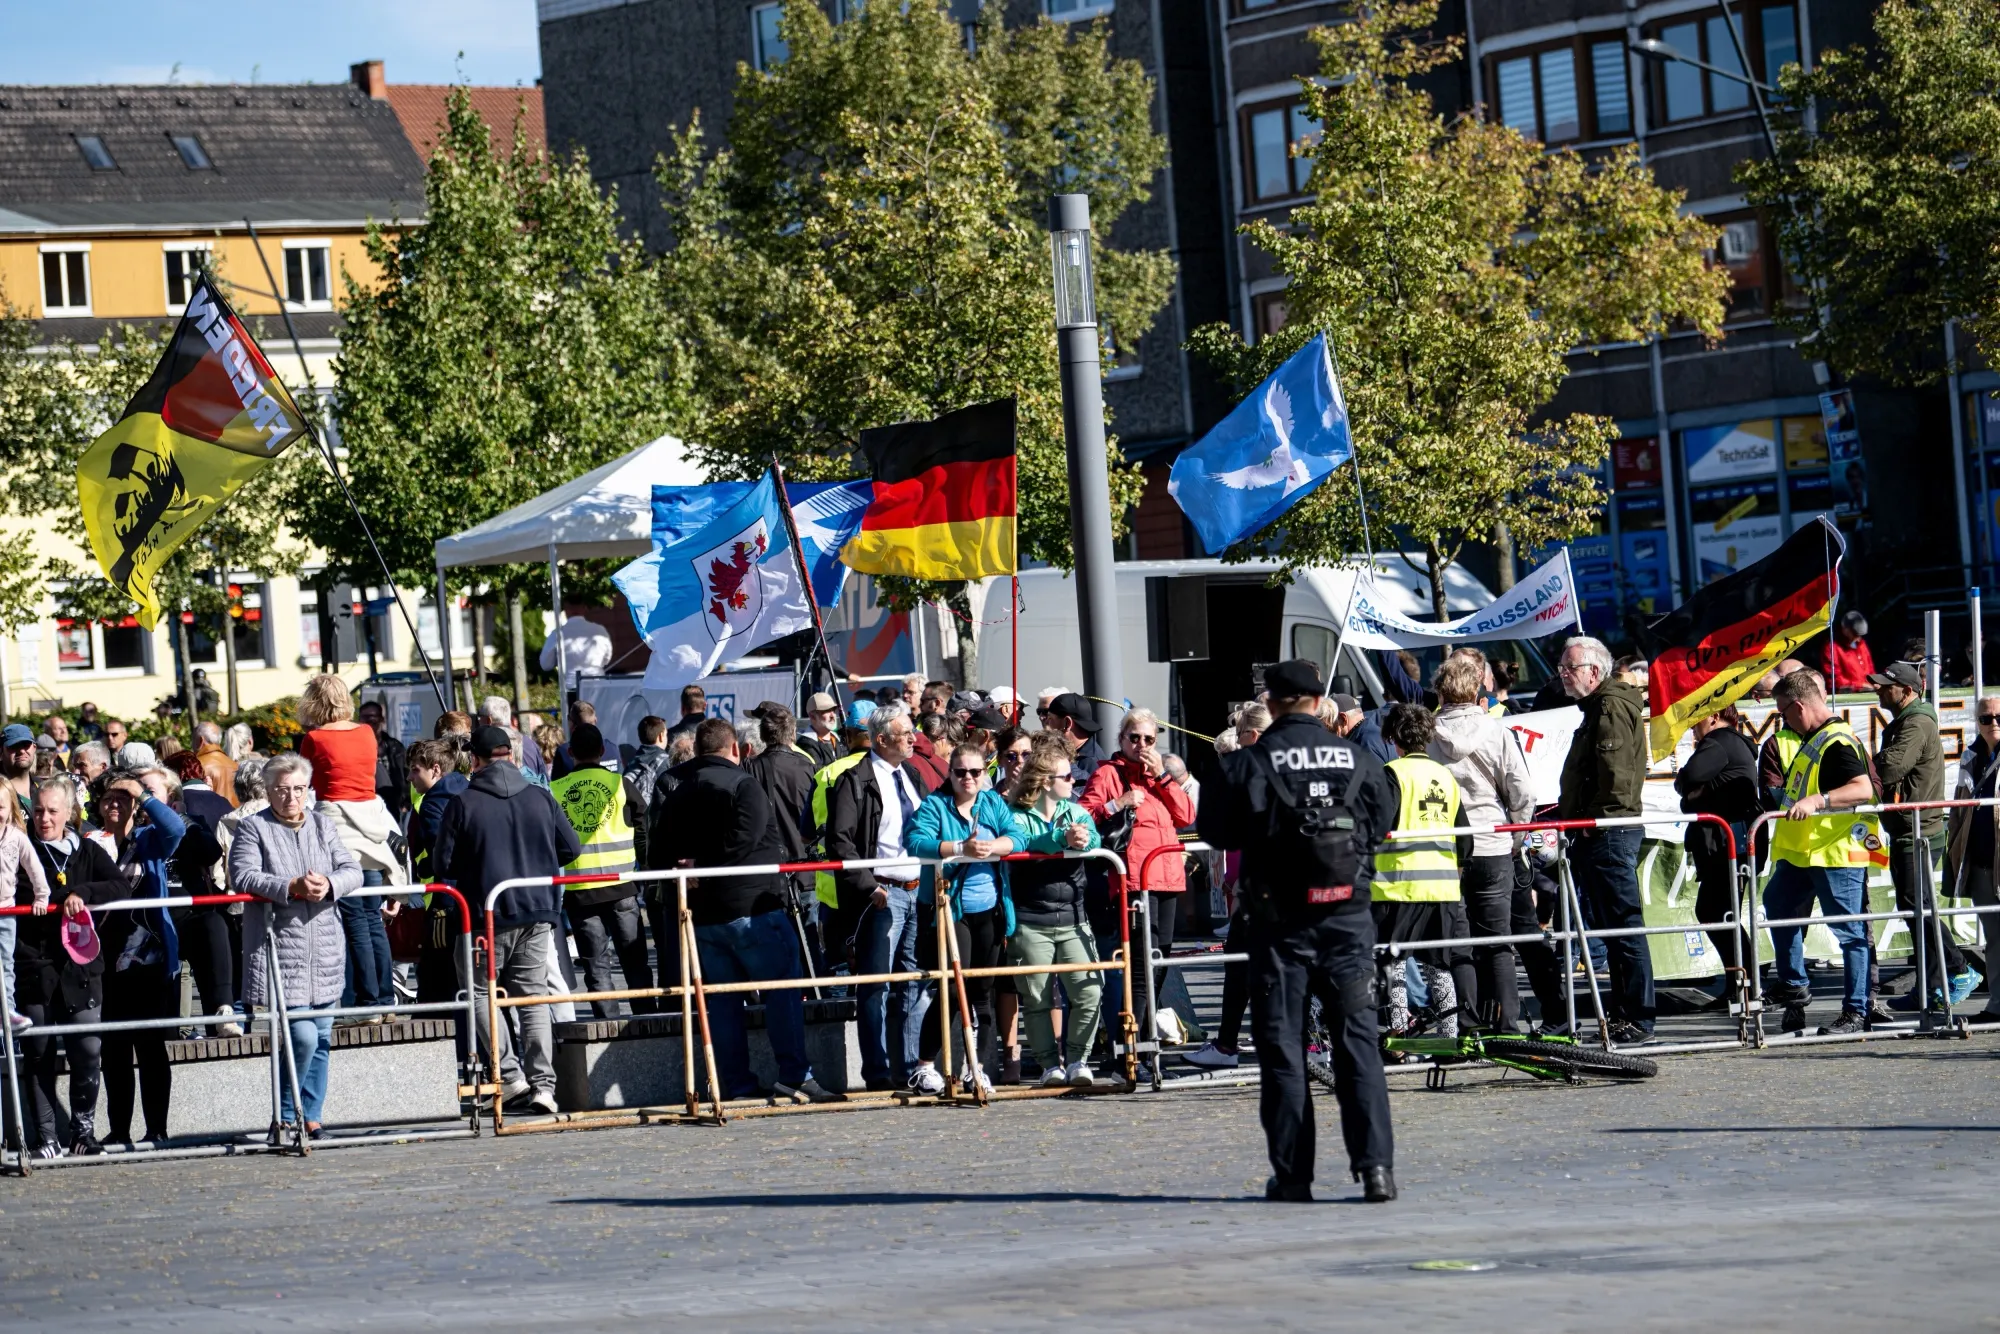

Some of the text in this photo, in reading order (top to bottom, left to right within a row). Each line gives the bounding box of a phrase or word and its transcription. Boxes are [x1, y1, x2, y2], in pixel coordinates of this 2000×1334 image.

[1718, 446, 1769, 464] TechniSat
[1270, 745, 1355, 773] POLIZEI
[1309, 781, 1329, 797] BB
[1312, 886, 1350, 902] MEDIC
